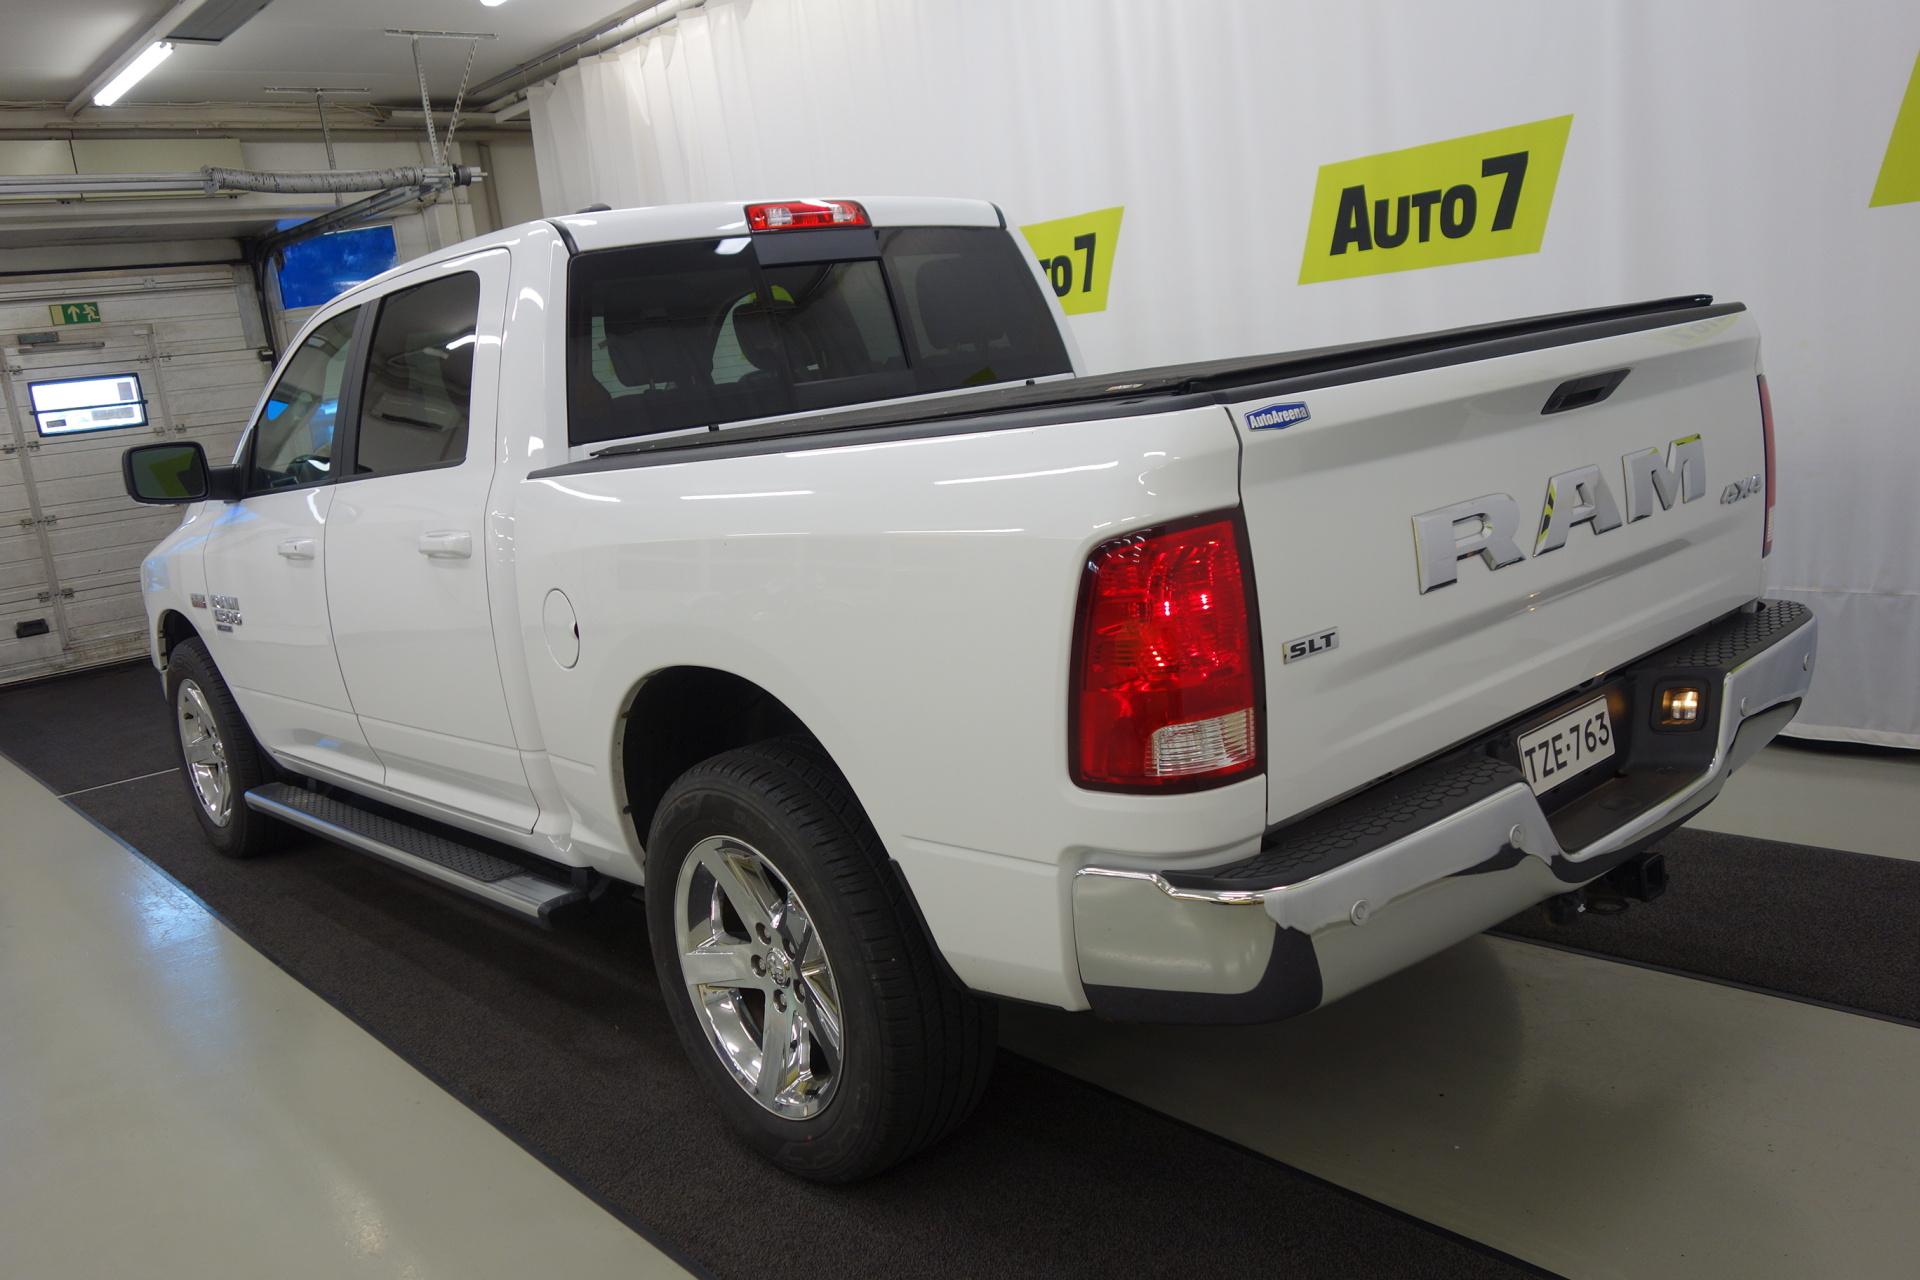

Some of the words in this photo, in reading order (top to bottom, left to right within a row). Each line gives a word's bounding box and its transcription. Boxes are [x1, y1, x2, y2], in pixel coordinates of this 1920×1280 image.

[1481, 150, 1529, 232] 7
[1074, 232, 1096, 293] 7
[1248, 406, 1308, 429] AutoAreena
[1411, 433, 1706, 596] RAM
[1290, 632, 1336, 659] SLT
[1524, 711, 1610, 783] TZE-763
